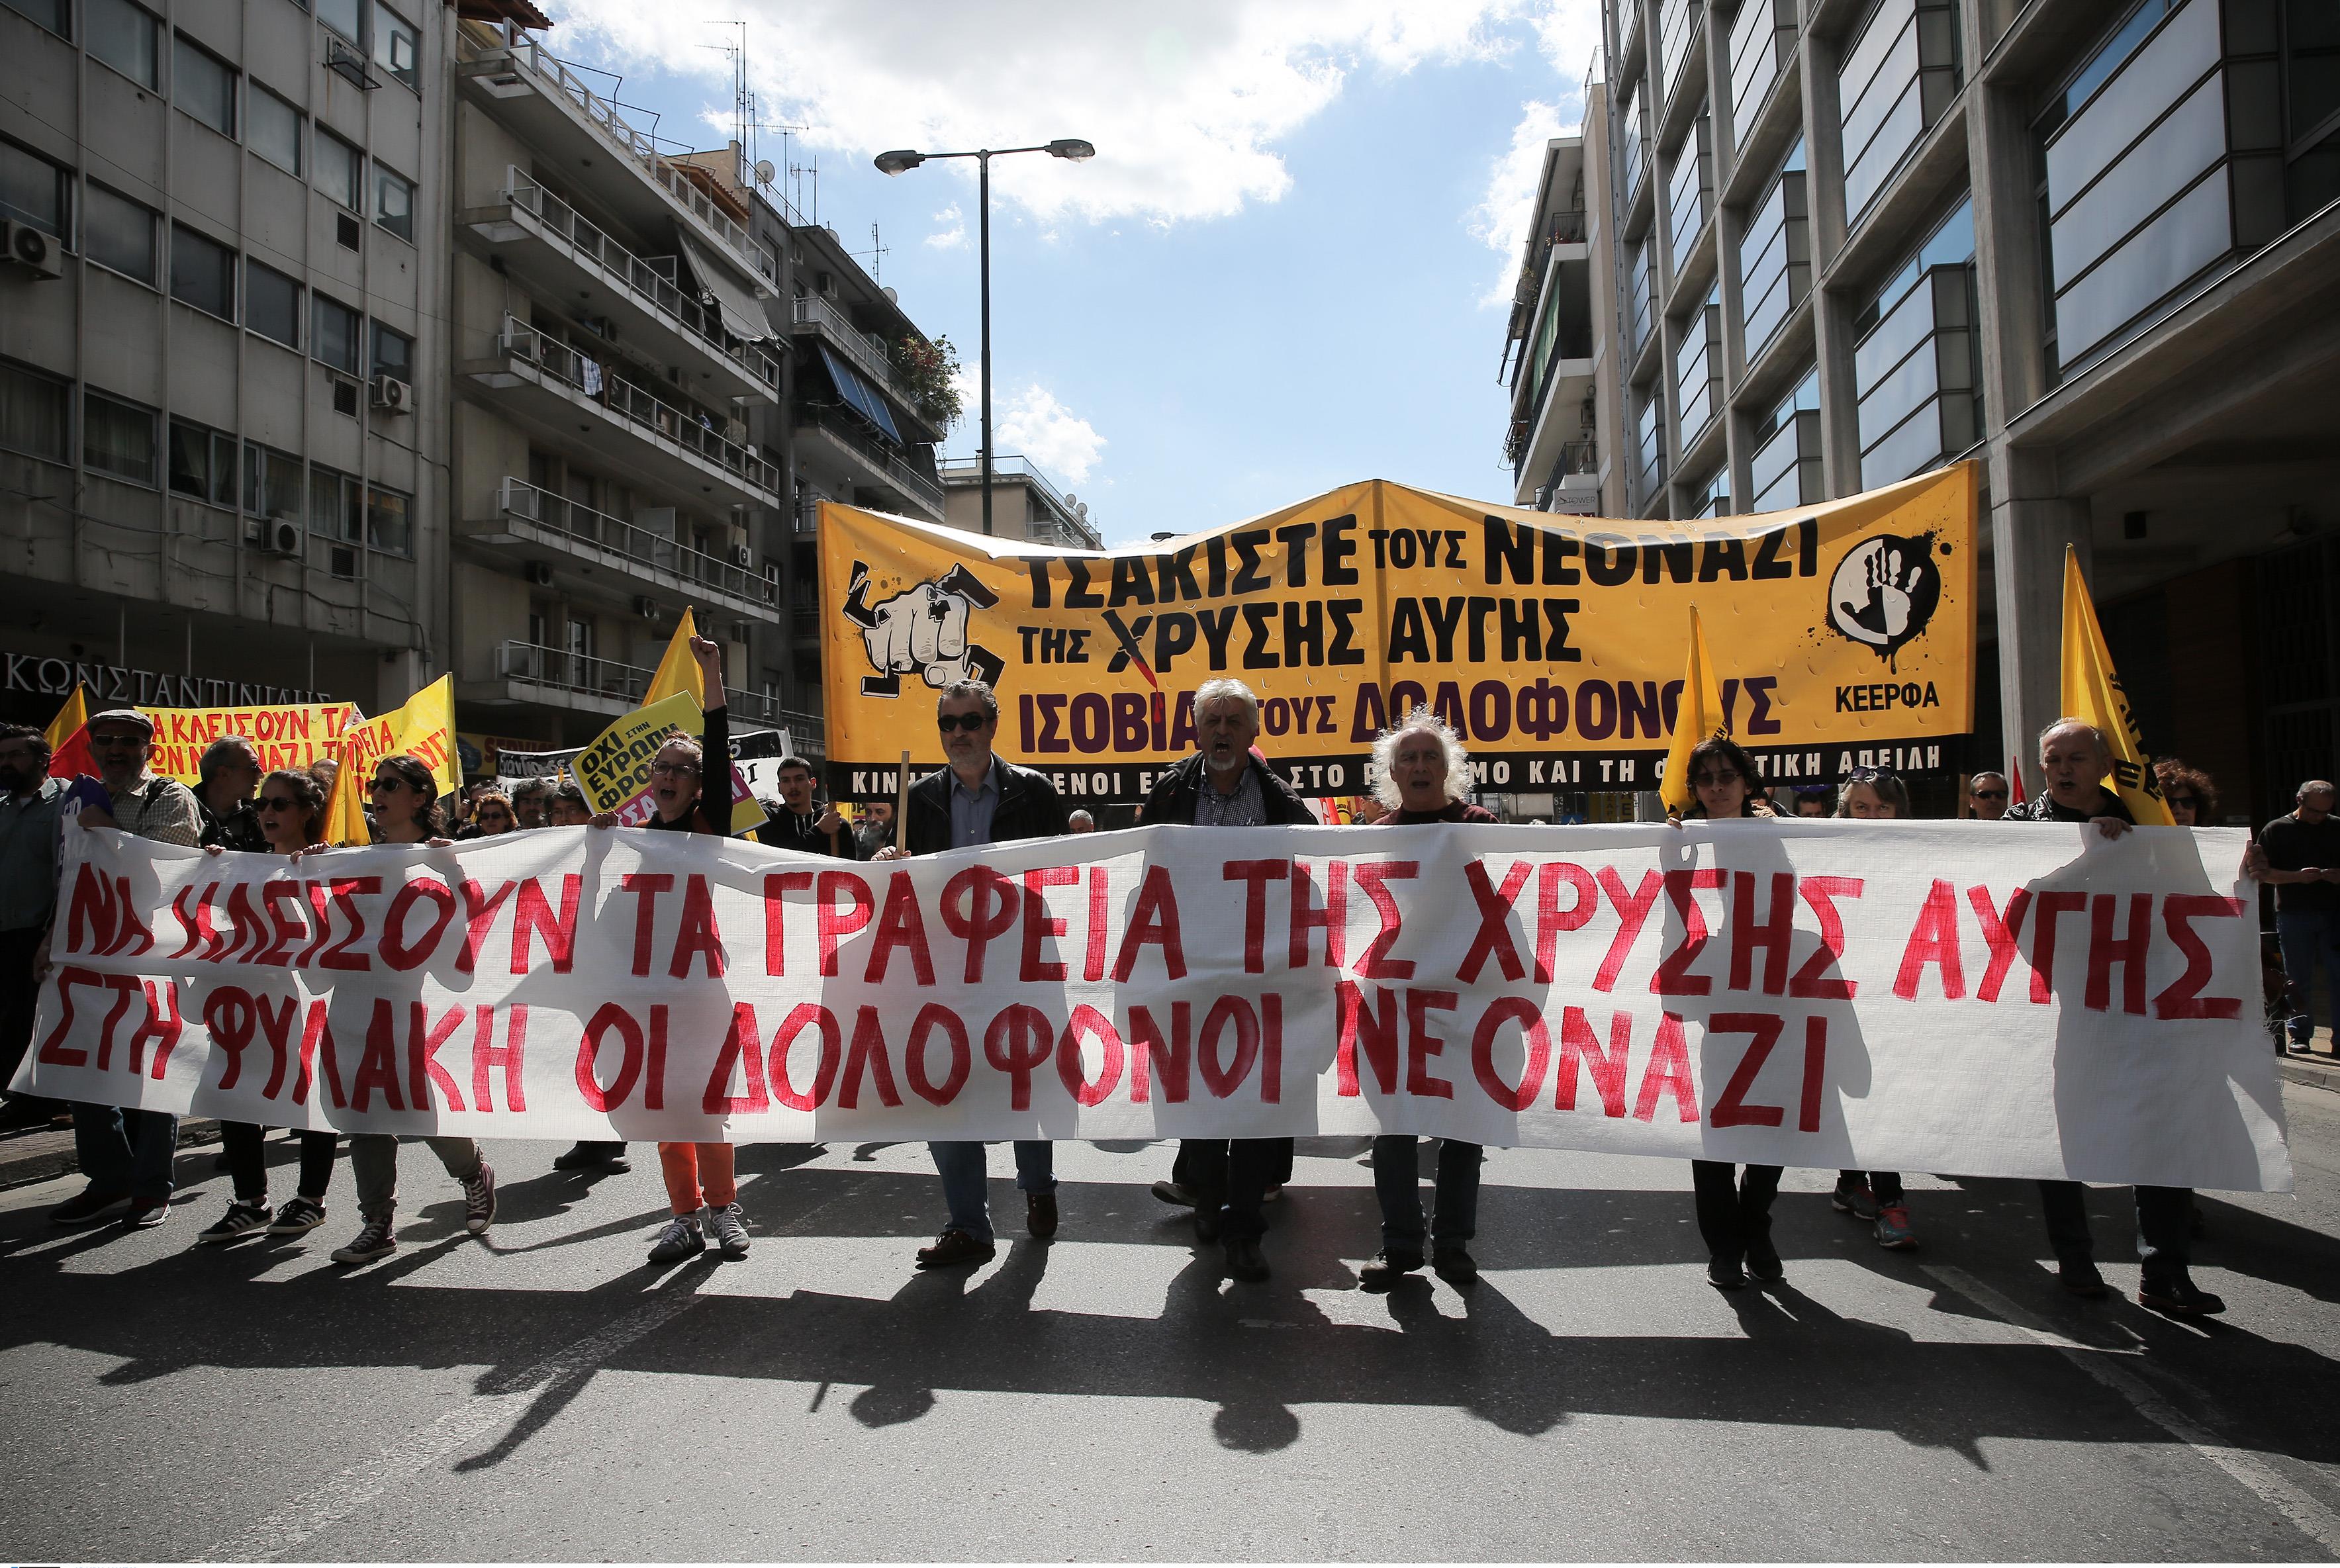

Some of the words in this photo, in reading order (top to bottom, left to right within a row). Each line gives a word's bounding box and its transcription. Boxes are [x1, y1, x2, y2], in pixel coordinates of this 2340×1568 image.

[1568, 496, 1596, 504] TOWER
[1018, 514, 1359, 609] ΤΣΑΚΙΣΤΕ
[1368, 529, 1468, 570] ΤΟΥΣ
[1483, 514, 1818, 587] ΝΕΟΝΑΖΙ
[1017, 625, 1092, 664] ΤΗΣ
[1101, 598, 1365, 674] ΧΡΥΣΗΣ
[1387, 596, 1581, 663] ΑΥΓΗΣ
[1019, 690, 1203, 753] ΙΣΟΒΙΑ
[1835, 680, 1940, 713] ΚΕΕΡΦΑ
[171, 709, 309, 743] ΚΛΕΙΣΟΥΝ
[581, 731, 625, 774] ΟΧΙ
[625, 721, 651, 739] ΣΤΗΝ
[1289, 764, 1344, 789] ΣΤΟ
[1529, 760, 1580, 784] ΚΑΙ
[1599, 759, 1635, 782] ΤΗ
[1838, 745, 1940, 774] ΑΠΕΙΛΗ
[68, 861, 155, 957] ΝΑ
[168, 874, 583, 975] ΚΛΕΙΣΟΥΝ
[622, 874, 725, 980] ΤΑ
[764, 864, 1188, 987] ΓΡΑΦΕΙΑ
[1222, 860, 1421, 980] ΤΗΣ
[1456, 859, 1865, 1000] ΧΡΥΣΗΣ
[1892, 878, 2249, 1020] ΑΥΓΗΣ
[38, 967, 183, 1081] ΣΤΗ
[203, 985, 528, 1113] ΦΥΛΑΚΗ
[575, 1002, 669, 1113] ΟΙ
[702, 994, 1282, 1115] ΔΟΛΟΦΟΝΟΙ
[1335, 980, 1828, 1132] ΝΕΟΝΑΖΙ
